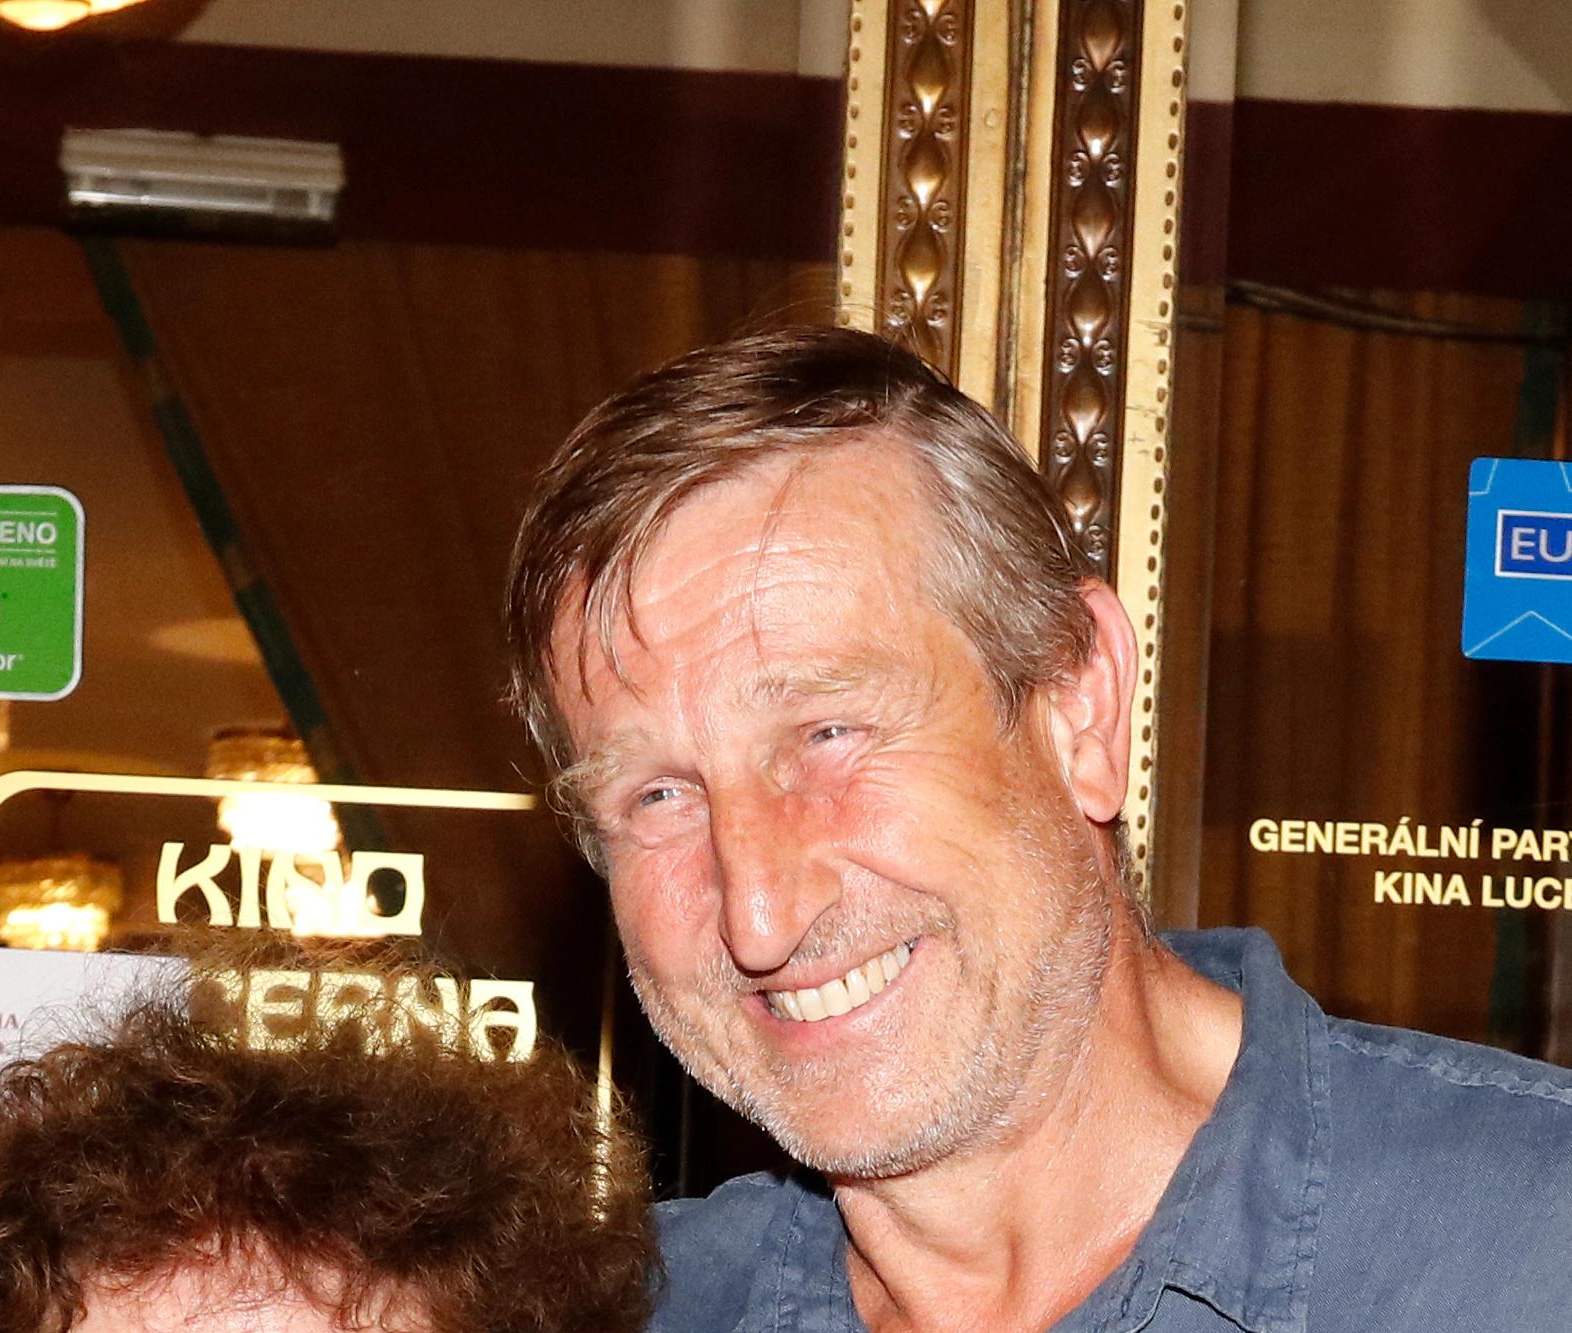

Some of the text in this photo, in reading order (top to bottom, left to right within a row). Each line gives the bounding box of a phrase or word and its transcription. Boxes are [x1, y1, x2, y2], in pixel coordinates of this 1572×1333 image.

[1249, 816, 1484, 859] GENERÁLNÍ
[156, 841, 425, 937] KINO
[1374, 871, 1471, 906] KINA
